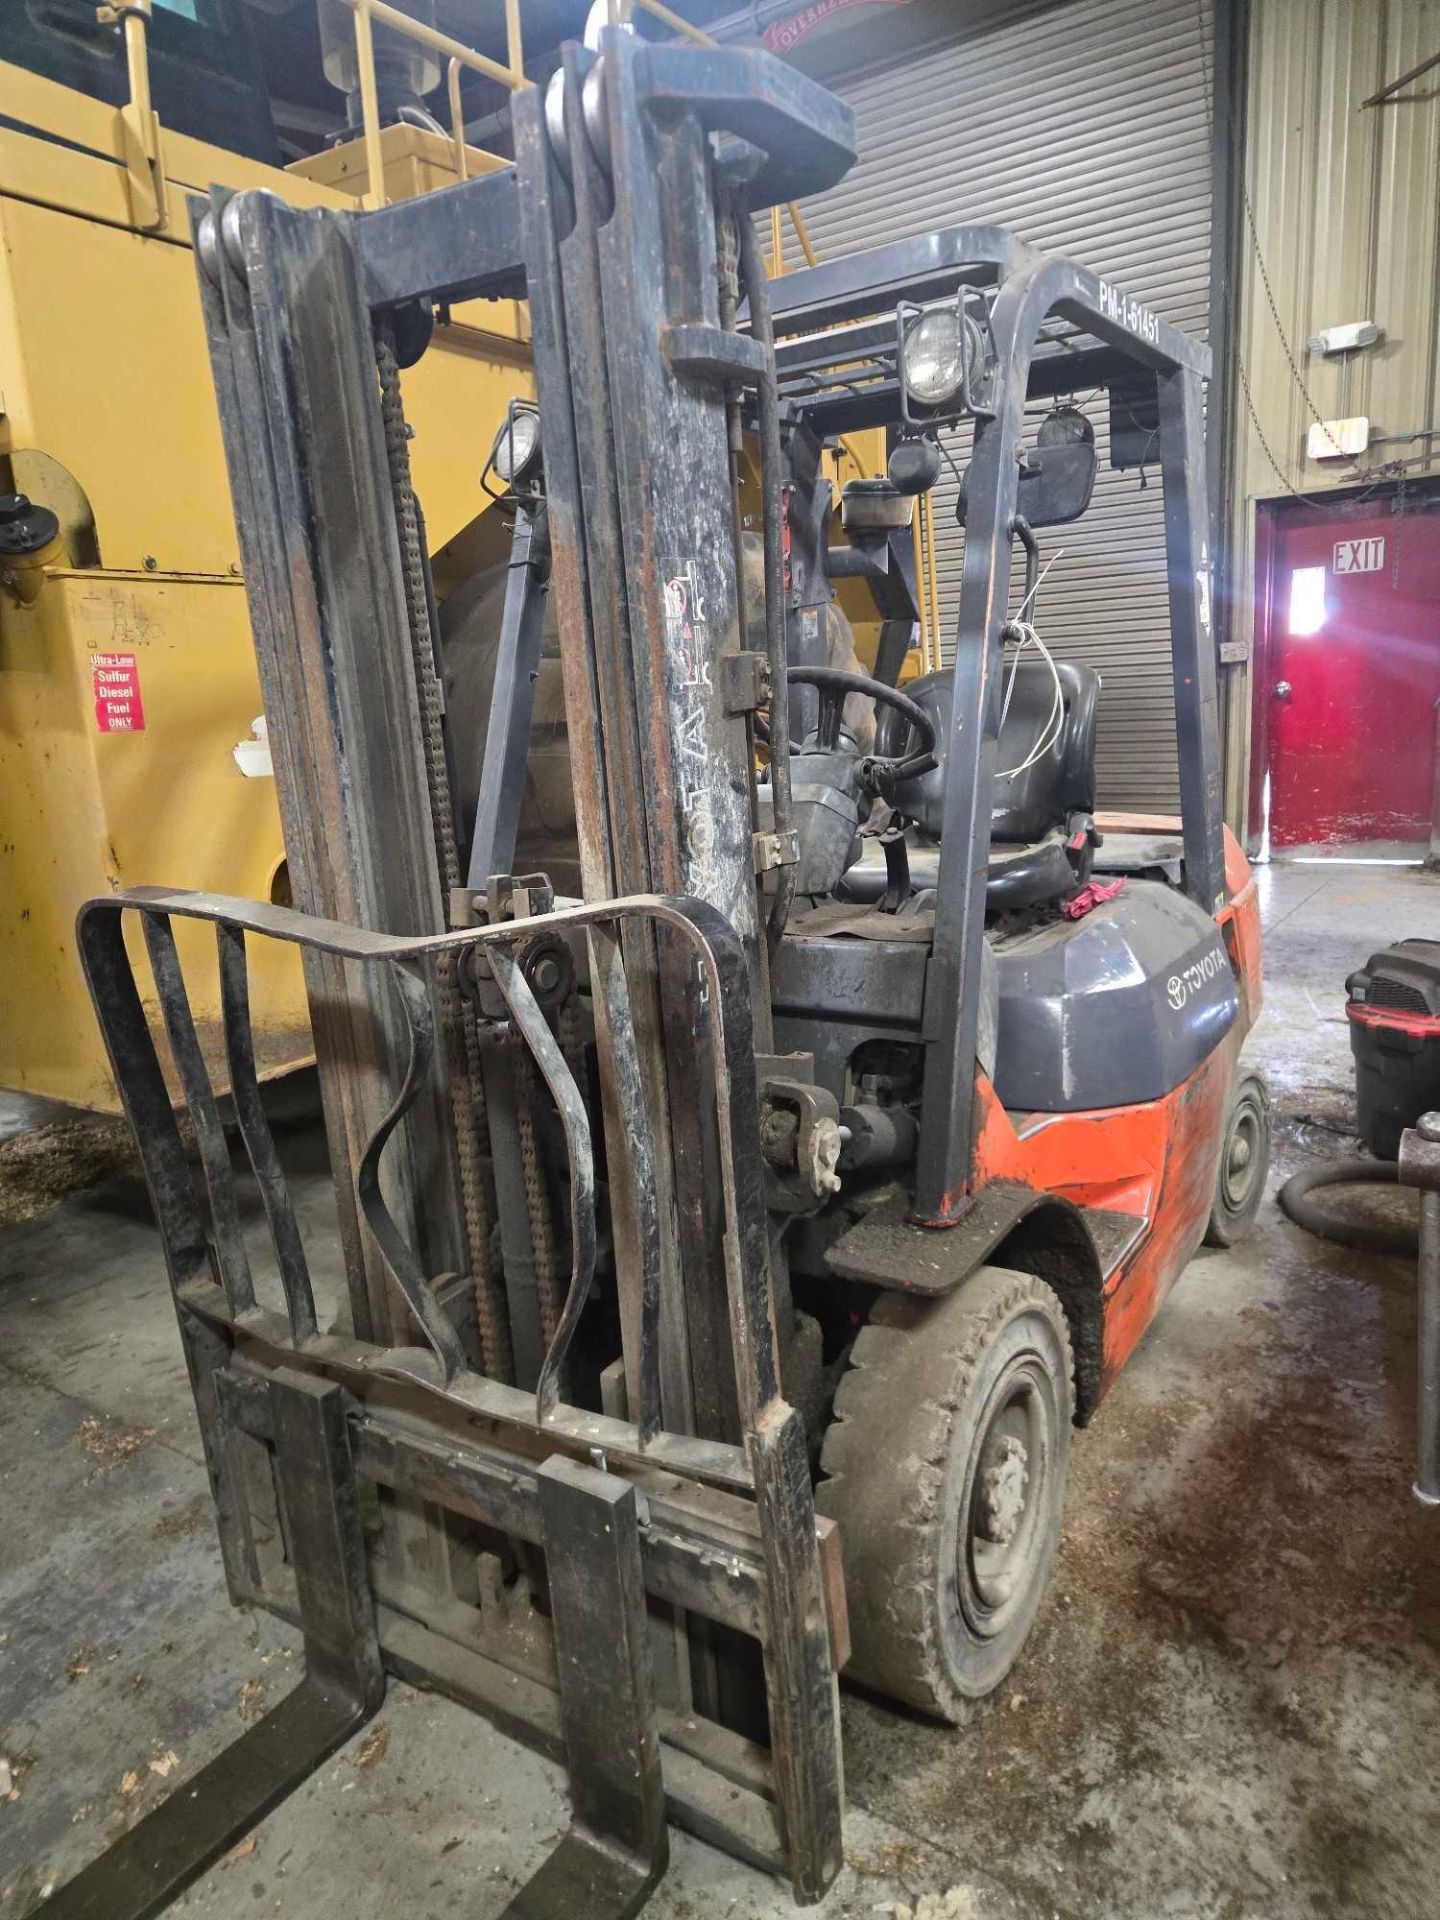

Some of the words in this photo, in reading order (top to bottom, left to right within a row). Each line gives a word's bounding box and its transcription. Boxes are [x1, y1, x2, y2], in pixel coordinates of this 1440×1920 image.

[1100, 280, 1159, 344] PM-1-61451
[1335, 540, 1383, 571] EXIT
[91, 654, 134, 665] Ultra-Low
[98, 671, 130, 682] Sulfur
[99, 687, 133, 698] Diesel
[107, 702, 130, 713] Fuel
[108, 718, 132, 728] ONLY
[1183, 947, 1226, 994] TOYOTA
